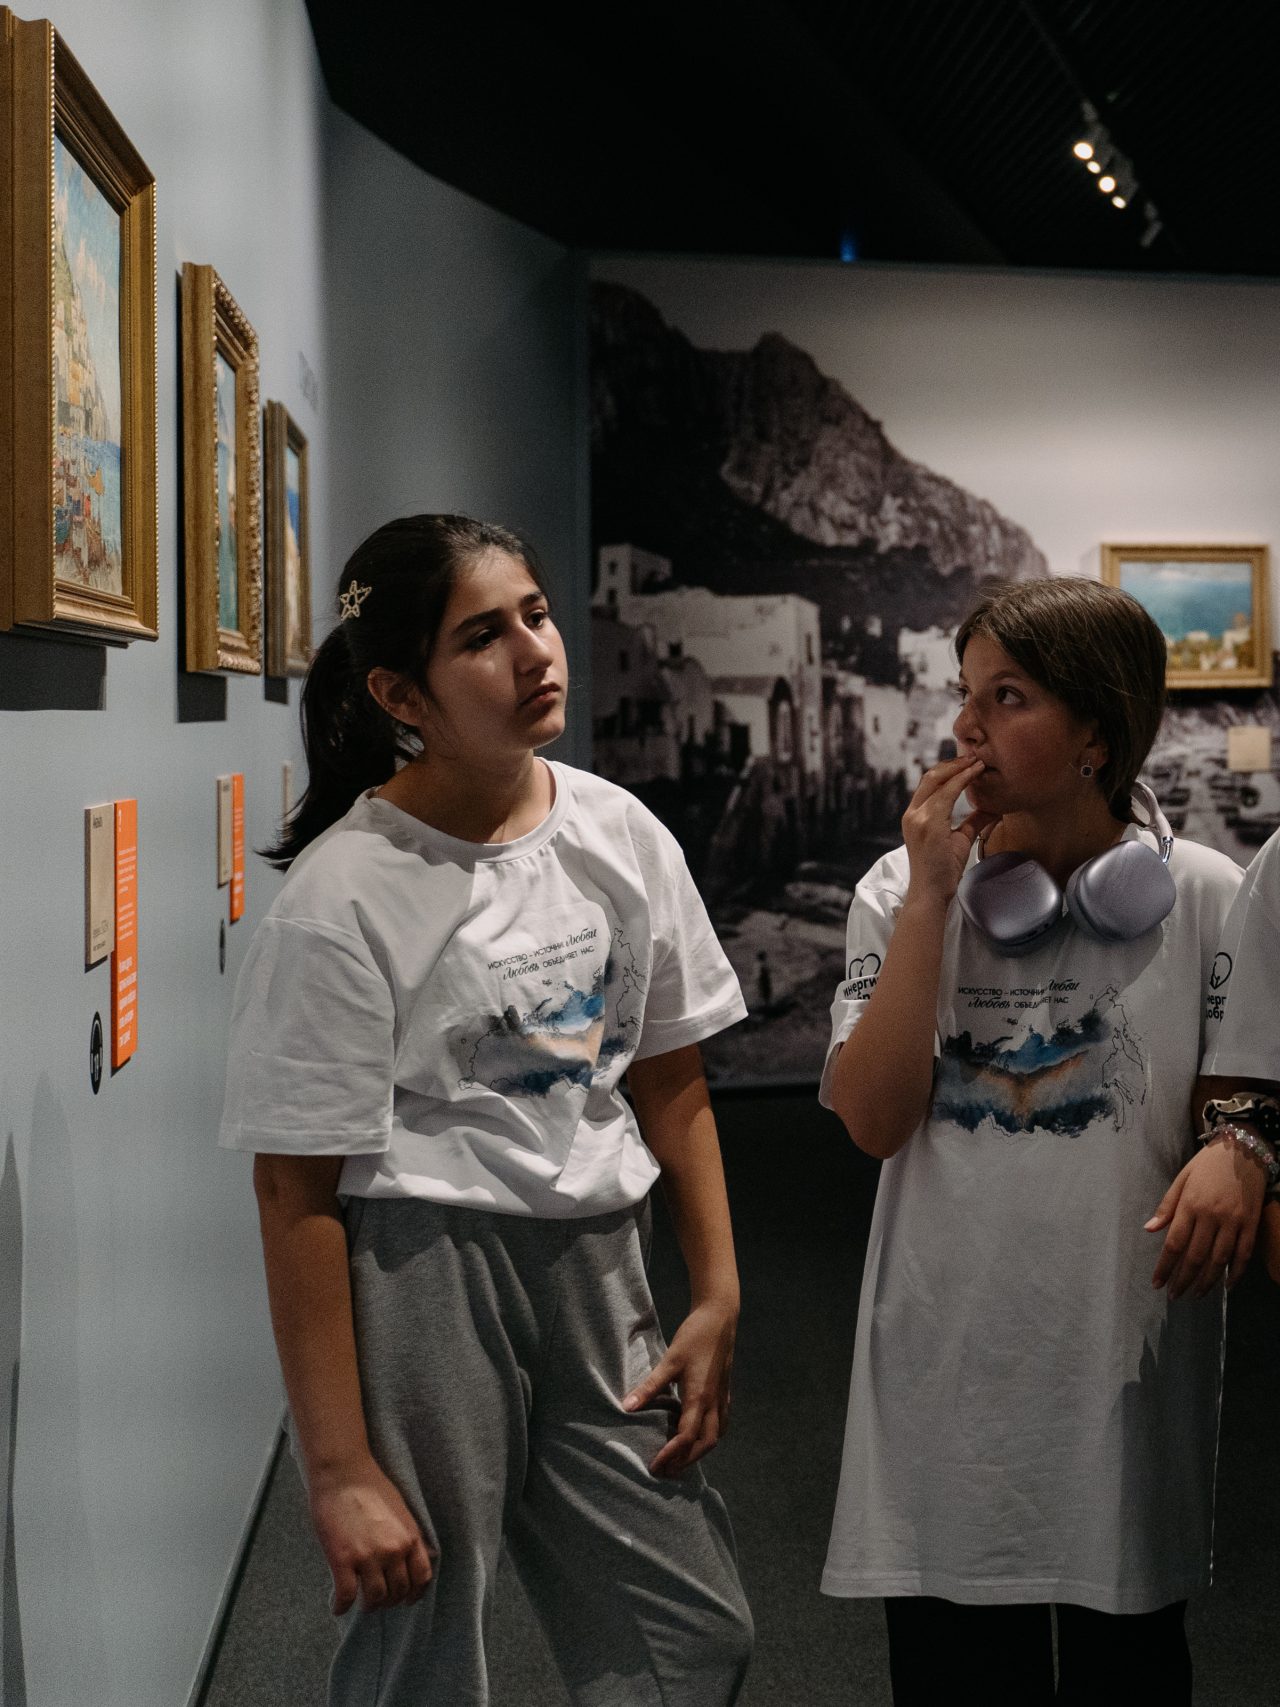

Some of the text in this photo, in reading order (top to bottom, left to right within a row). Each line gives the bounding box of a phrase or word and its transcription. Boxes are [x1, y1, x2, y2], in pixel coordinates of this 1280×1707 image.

[580, 945, 595, 956] НАС
[487, 953, 528, 971] ИСКУССТВО
[958, 986, 1003, 996] ИСКУССТВО
[1053, 996, 1069, 1004] НАС
